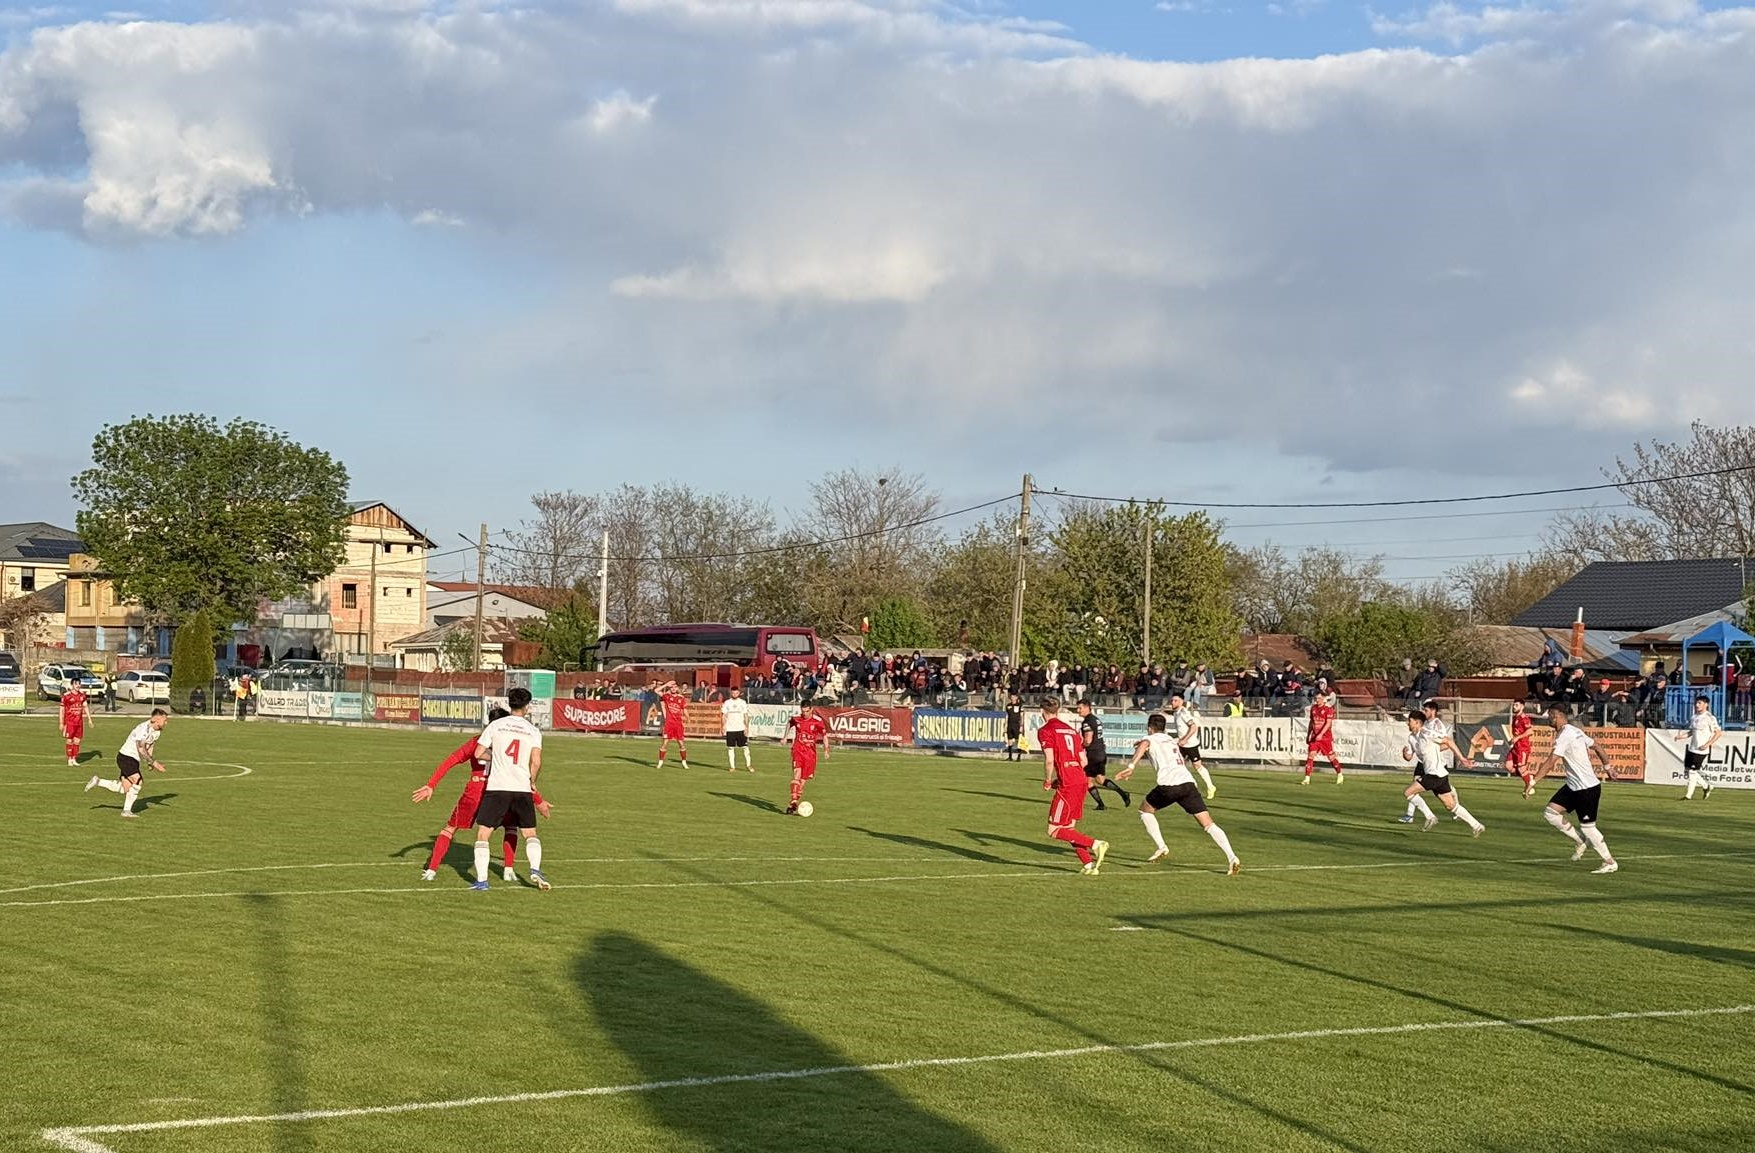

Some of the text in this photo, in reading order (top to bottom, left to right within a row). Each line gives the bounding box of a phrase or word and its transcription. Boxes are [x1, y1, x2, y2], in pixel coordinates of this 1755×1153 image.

[564, 704, 626, 726] SUPERSCORE
[829, 717, 890, 733] VALGRIG
[917, 715, 963, 740] CONSILIUL
[965, 716, 992, 742] LOCAL
[993, 717, 1007, 742] LIE
[1255, 727, 1288, 752] S.R.L.
[505, 739, 520, 765] 4
[1064, 734, 1075, 758] 9
[1600, 743, 1640, 752] ONSTRUCȚIE
[1702, 764, 1728, 772] Media
[1744, 775, 1752, 783] &
